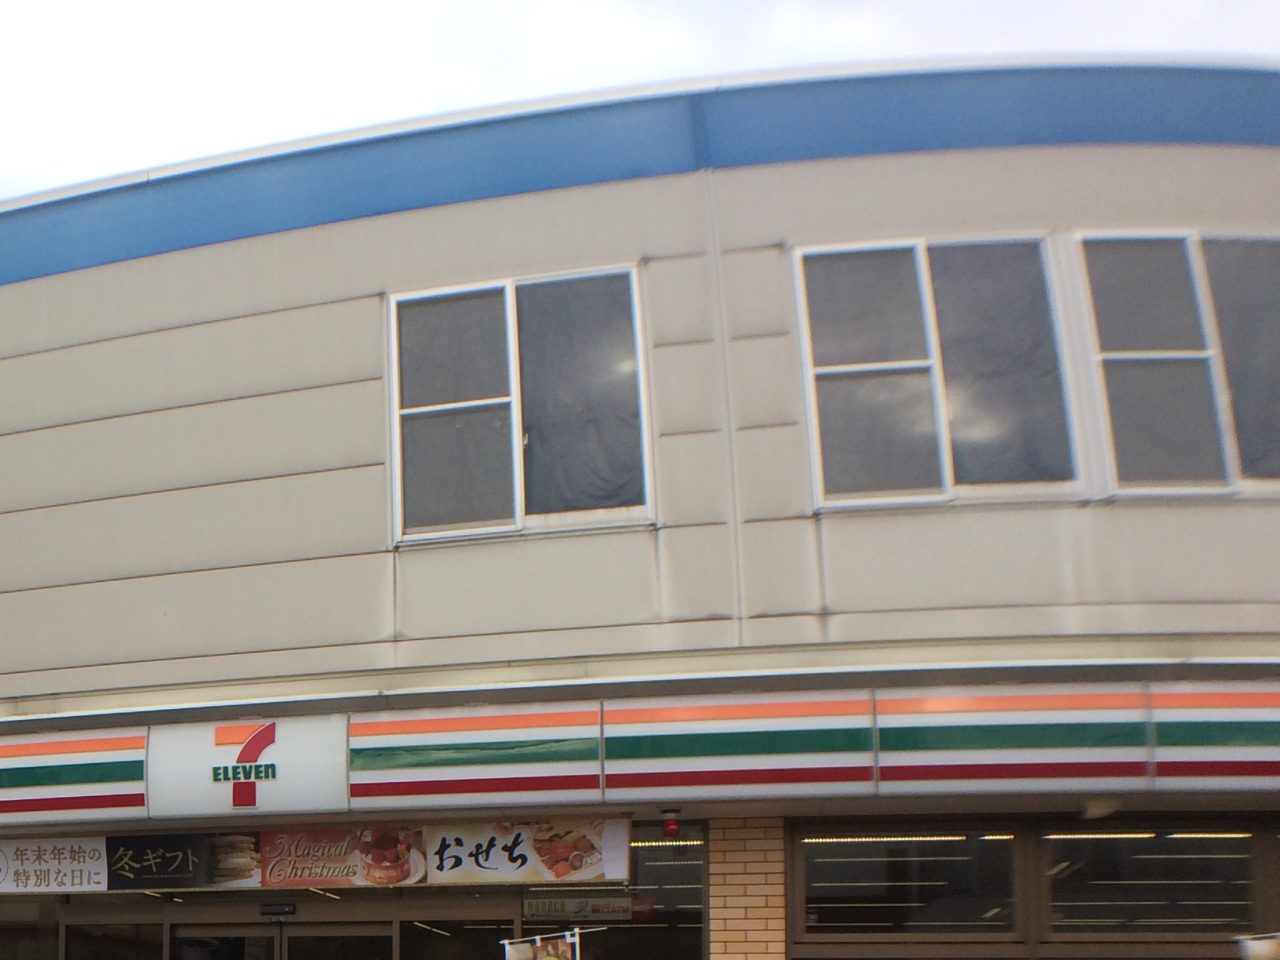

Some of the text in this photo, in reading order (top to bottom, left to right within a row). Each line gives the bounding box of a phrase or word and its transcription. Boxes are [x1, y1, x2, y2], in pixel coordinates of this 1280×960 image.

[215, 721, 277, 808] 7
[13, 845, 102, 866] 年末年始の
[267, 834, 352, 860] Magical
[433, 833, 528, 872] おせち
[111, 847, 200, 879] 冬ギフト
[267, 858, 359, 884] Christmas
[13, 867, 102, 888] 特別な日に
